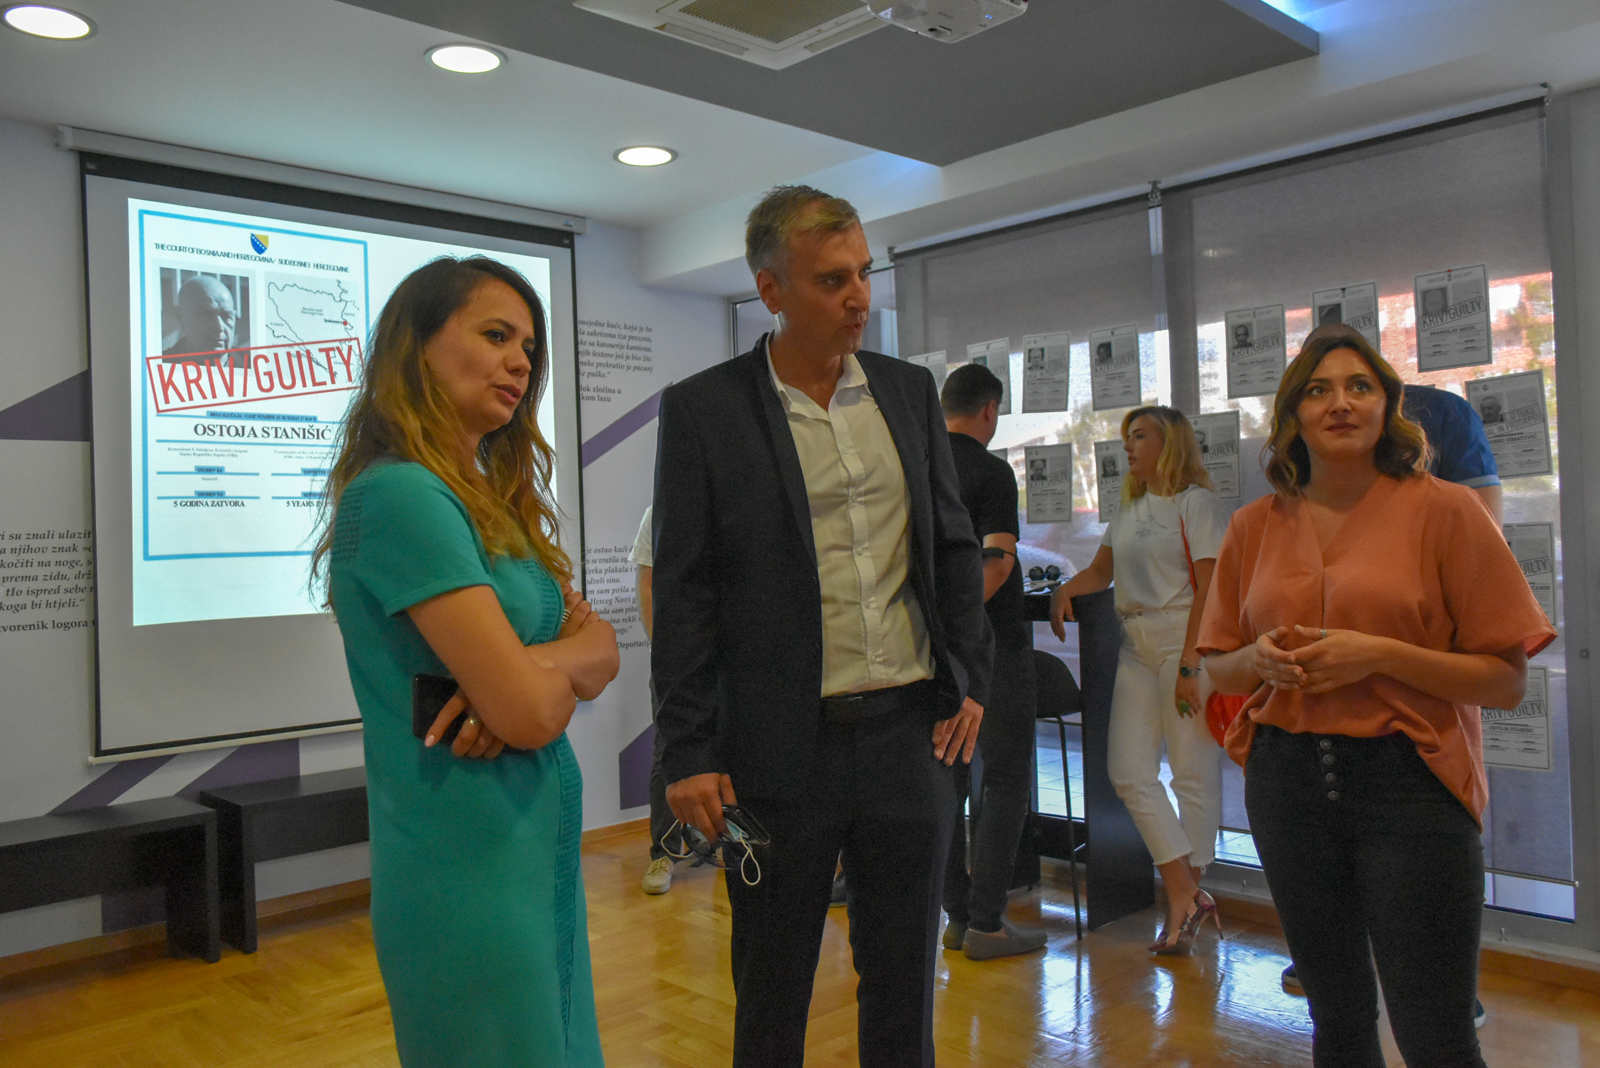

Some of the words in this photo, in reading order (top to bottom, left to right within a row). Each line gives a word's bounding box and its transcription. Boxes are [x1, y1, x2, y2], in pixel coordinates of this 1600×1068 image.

[154, 242, 166, 250] THE
[167, 244, 188, 252] COURT
[196, 248, 220, 256] BOSNIA
[313, 262, 350, 273] HERCEGOVINE
[156, 345, 354, 404] KRIV/GUILTY
[194, 423, 258, 438] OSTOJA
[262, 424, 332, 440] STANIŠIĆ
[8, 532, 22, 540] su
[26, 530, 56, 540] znali
[10, 544, 48, 558] njihov
[51, 543, 79, 553] znak
[54, 560, 84, 570] noge,
[2, 574, 38, 583] prema
[42, 571, 70, 582] zidu,
[26, 585, 60, 598] ispred
[64, 584, 87, 594] sebe
[30, 600, 42, 610] bi
[590, 597, 613, 606] Herceg
[614, 596, 631, 604] Novi
[52, 620, 88, 632] logora
